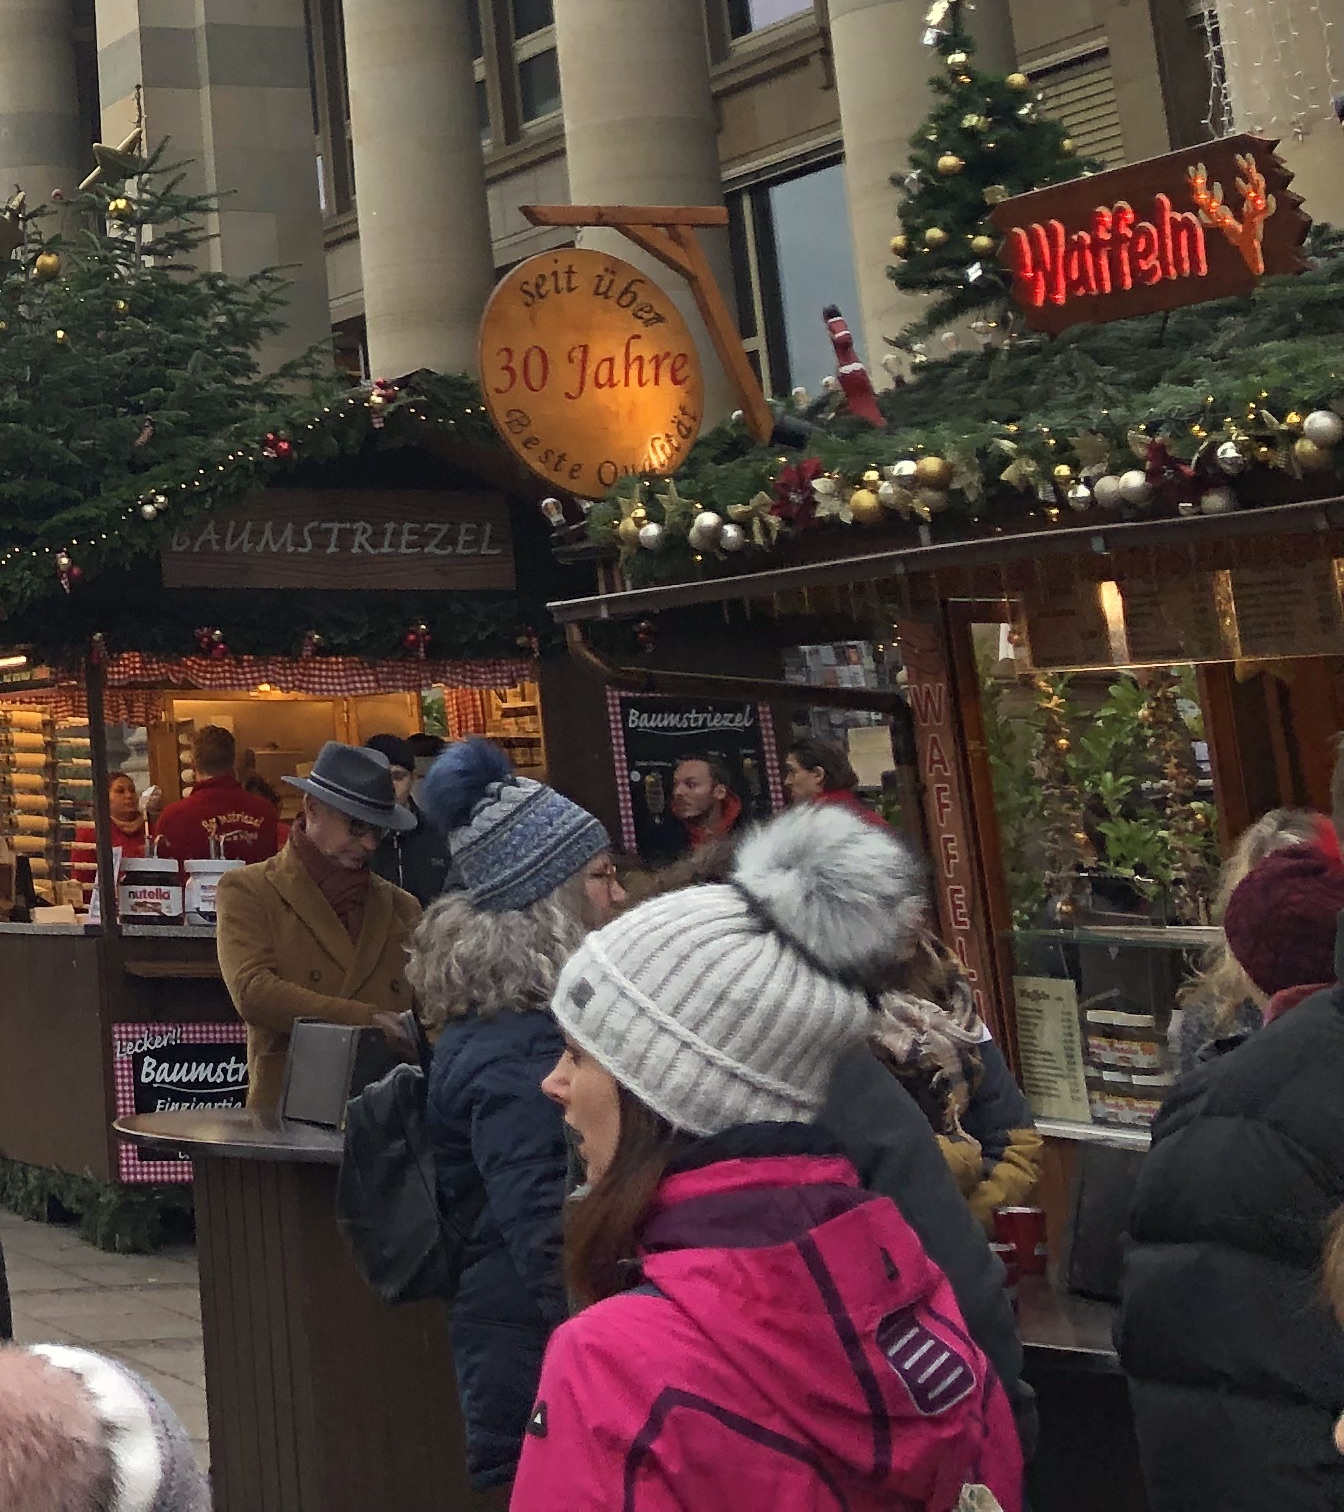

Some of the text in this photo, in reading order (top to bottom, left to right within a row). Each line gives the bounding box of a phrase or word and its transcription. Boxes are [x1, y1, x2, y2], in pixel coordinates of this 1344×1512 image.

[1010, 192, 1209, 307] Waffeln
[519, 258, 667, 328] seit über
[494, 333, 691, 400] 30 Jahre
[505, 407, 583, 480] Beste
[170, 521, 502, 555] BAUMSTRIEZEL
[628, 704, 754, 729] Baumstriezel
[128, 888, 171, 900] nutella
[116, 1025, 181, 1059] Lecker!!
